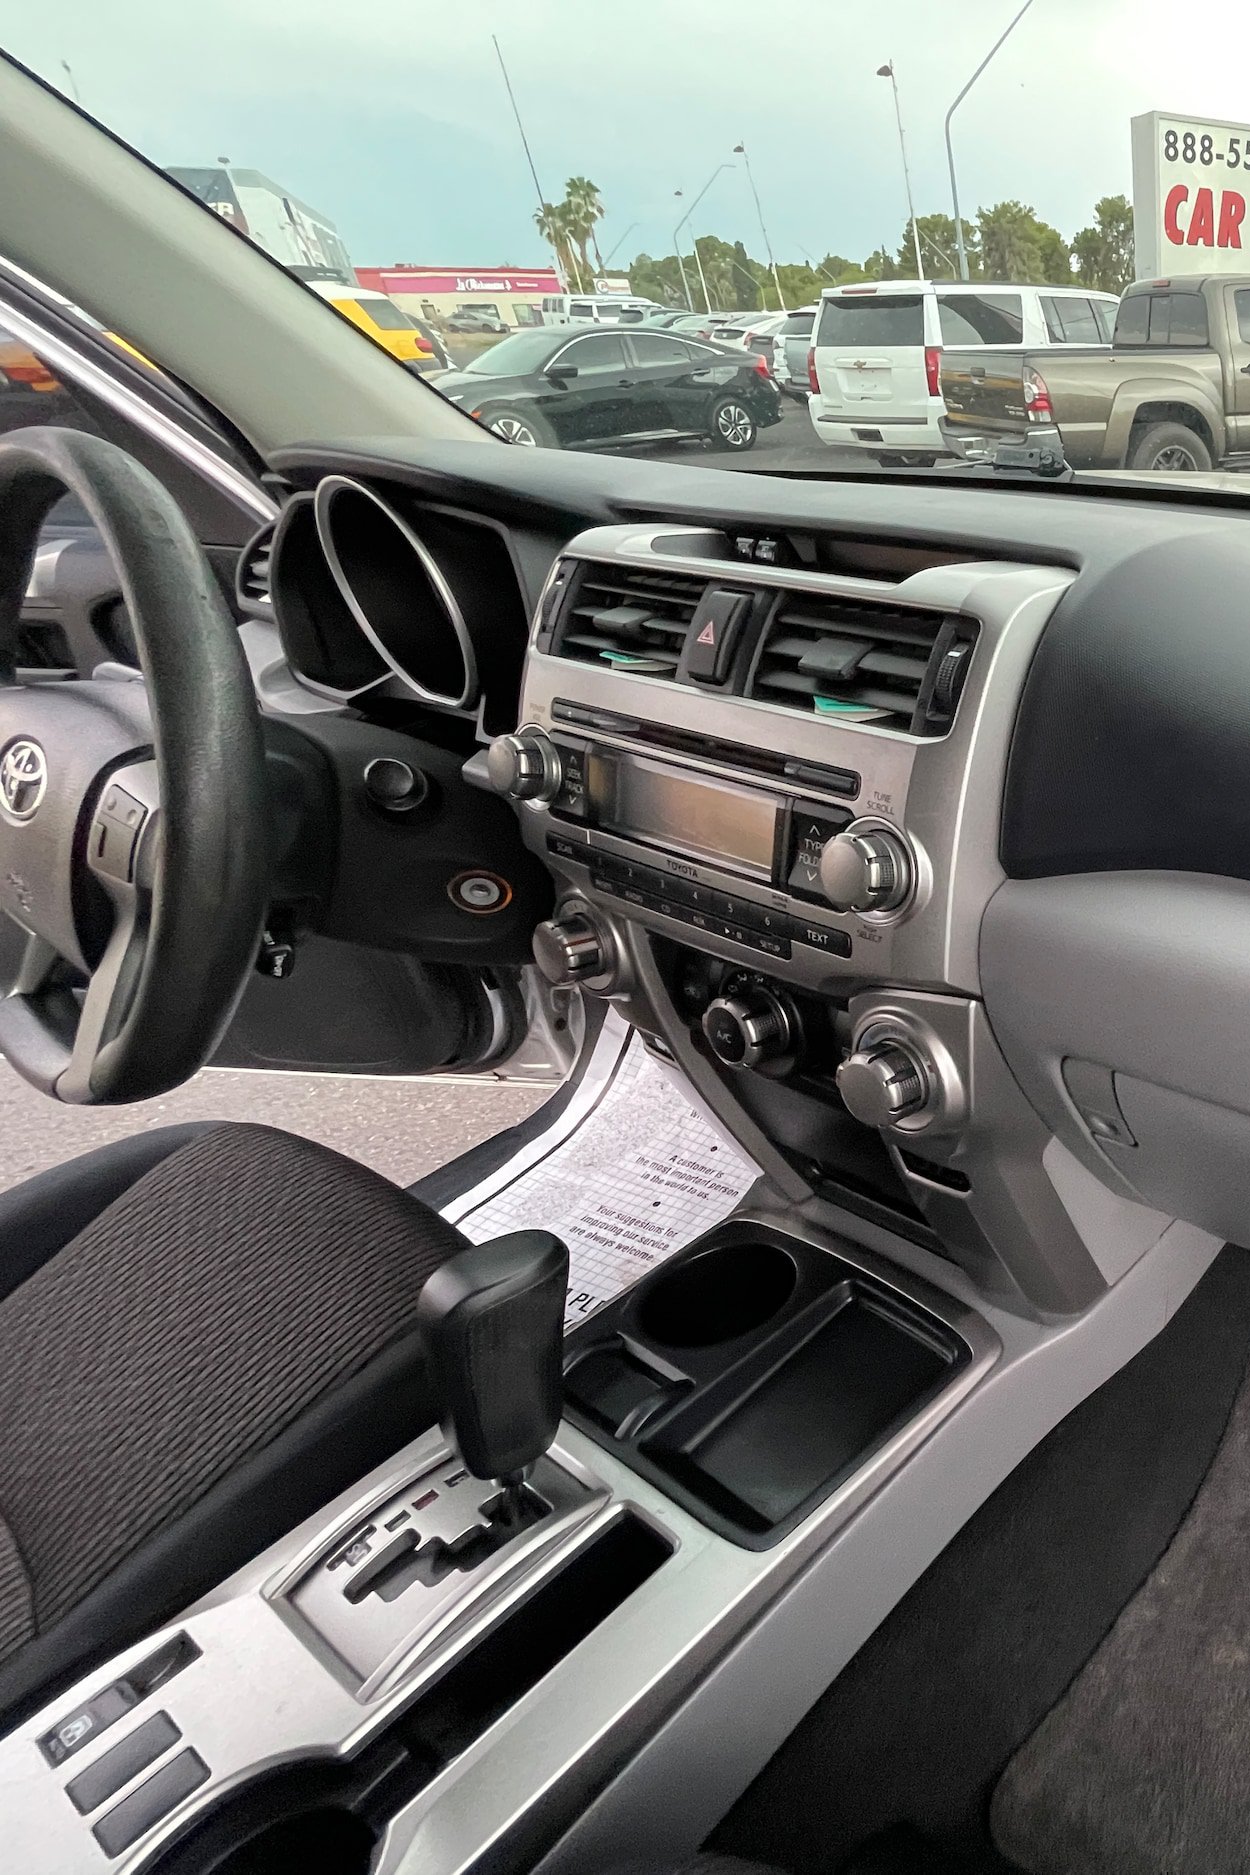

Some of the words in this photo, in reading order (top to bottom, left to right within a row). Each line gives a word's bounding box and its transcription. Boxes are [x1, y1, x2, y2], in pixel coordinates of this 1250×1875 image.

[1164, 184, 1246, 249] CAR
[866, 800, 895, 816] SCROLL
[873, 791, 892, 803] TUNE
[666, 859, 698, 878] TOYOTA
[627, 867, 633, 878] 2
[692, 891, 698, 900] 4
[727, 904, 734, 914] 5
[764, 916, 771, 927] 6
[806, 929, 829, 945] TEXT
[635, 1156, 650, 1166] the
[649, 1161, 672, 1175] most
[670, 1167, 712, 1187] important
[707, 1182, 739, 1198] person
[669, 1155, 678, 1163] A
[677, 1158, 716, 1176] customer
[715, 1170, 725, 1179] is
[641, 1171, 650, 1180] in
[650, 1174, 665, 1185] the
[664, 1180, 690, 1192] world
[687, 1186, 698, 1195] to
[697, 1191, 709, 1201] us.
[580, 1215, 624, 1237] improving
[622, 1230, 639, 1241] our
[637, 1236, 670, 1252] service
[596, 1204, 616, 1217] Your
[615, 1212, 665, 1235] suggestions
[664, 1227, 679, 1238] for
[569, 1225, 586, 1236] are
[584, 1231, 616, 1247] always
[615, 1242, 655, 1262] welcome.
